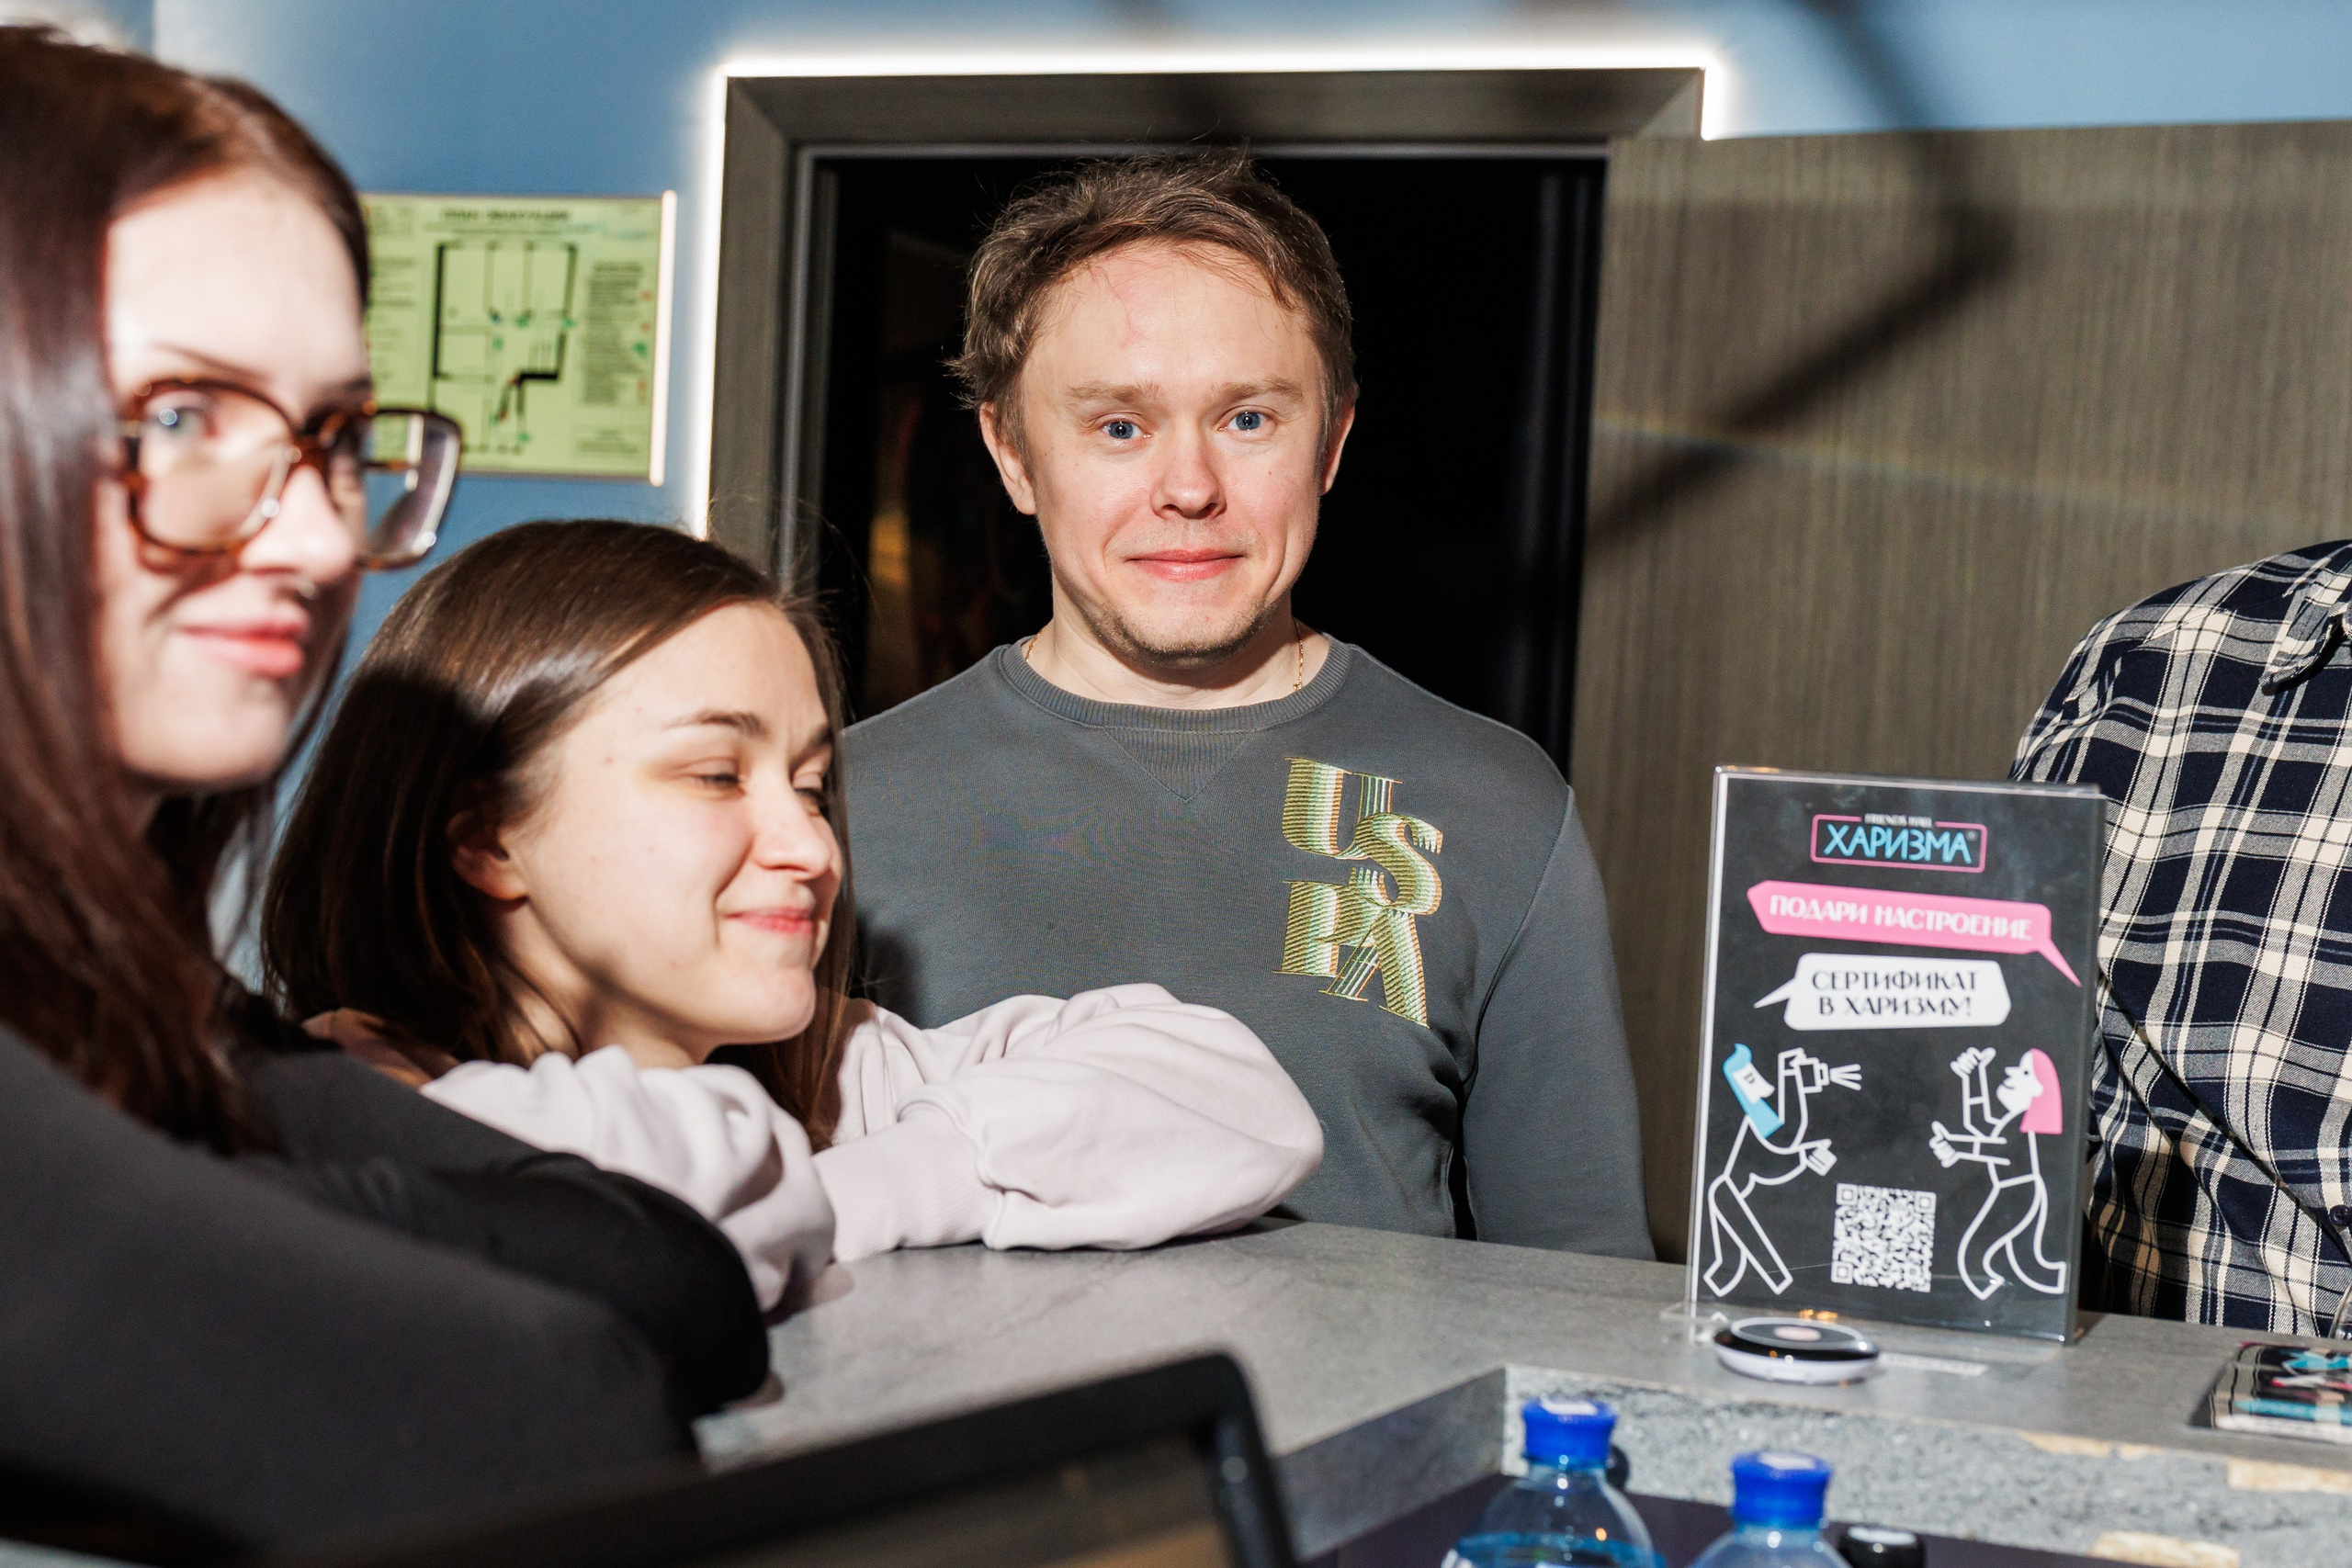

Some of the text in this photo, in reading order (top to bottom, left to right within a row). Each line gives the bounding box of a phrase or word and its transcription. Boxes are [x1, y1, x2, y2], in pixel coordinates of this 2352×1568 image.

[1823, 823, 1973, 863] ХАРИЗМА
[1769, 894, 2032, 940] ПОДАРИ НАСТРОЕНИЕ
[1811, 969, 1979, 992] СЕРТИФИКАТ
[1818, 995, 1973, 1017] В ХАРИЗМУ!
